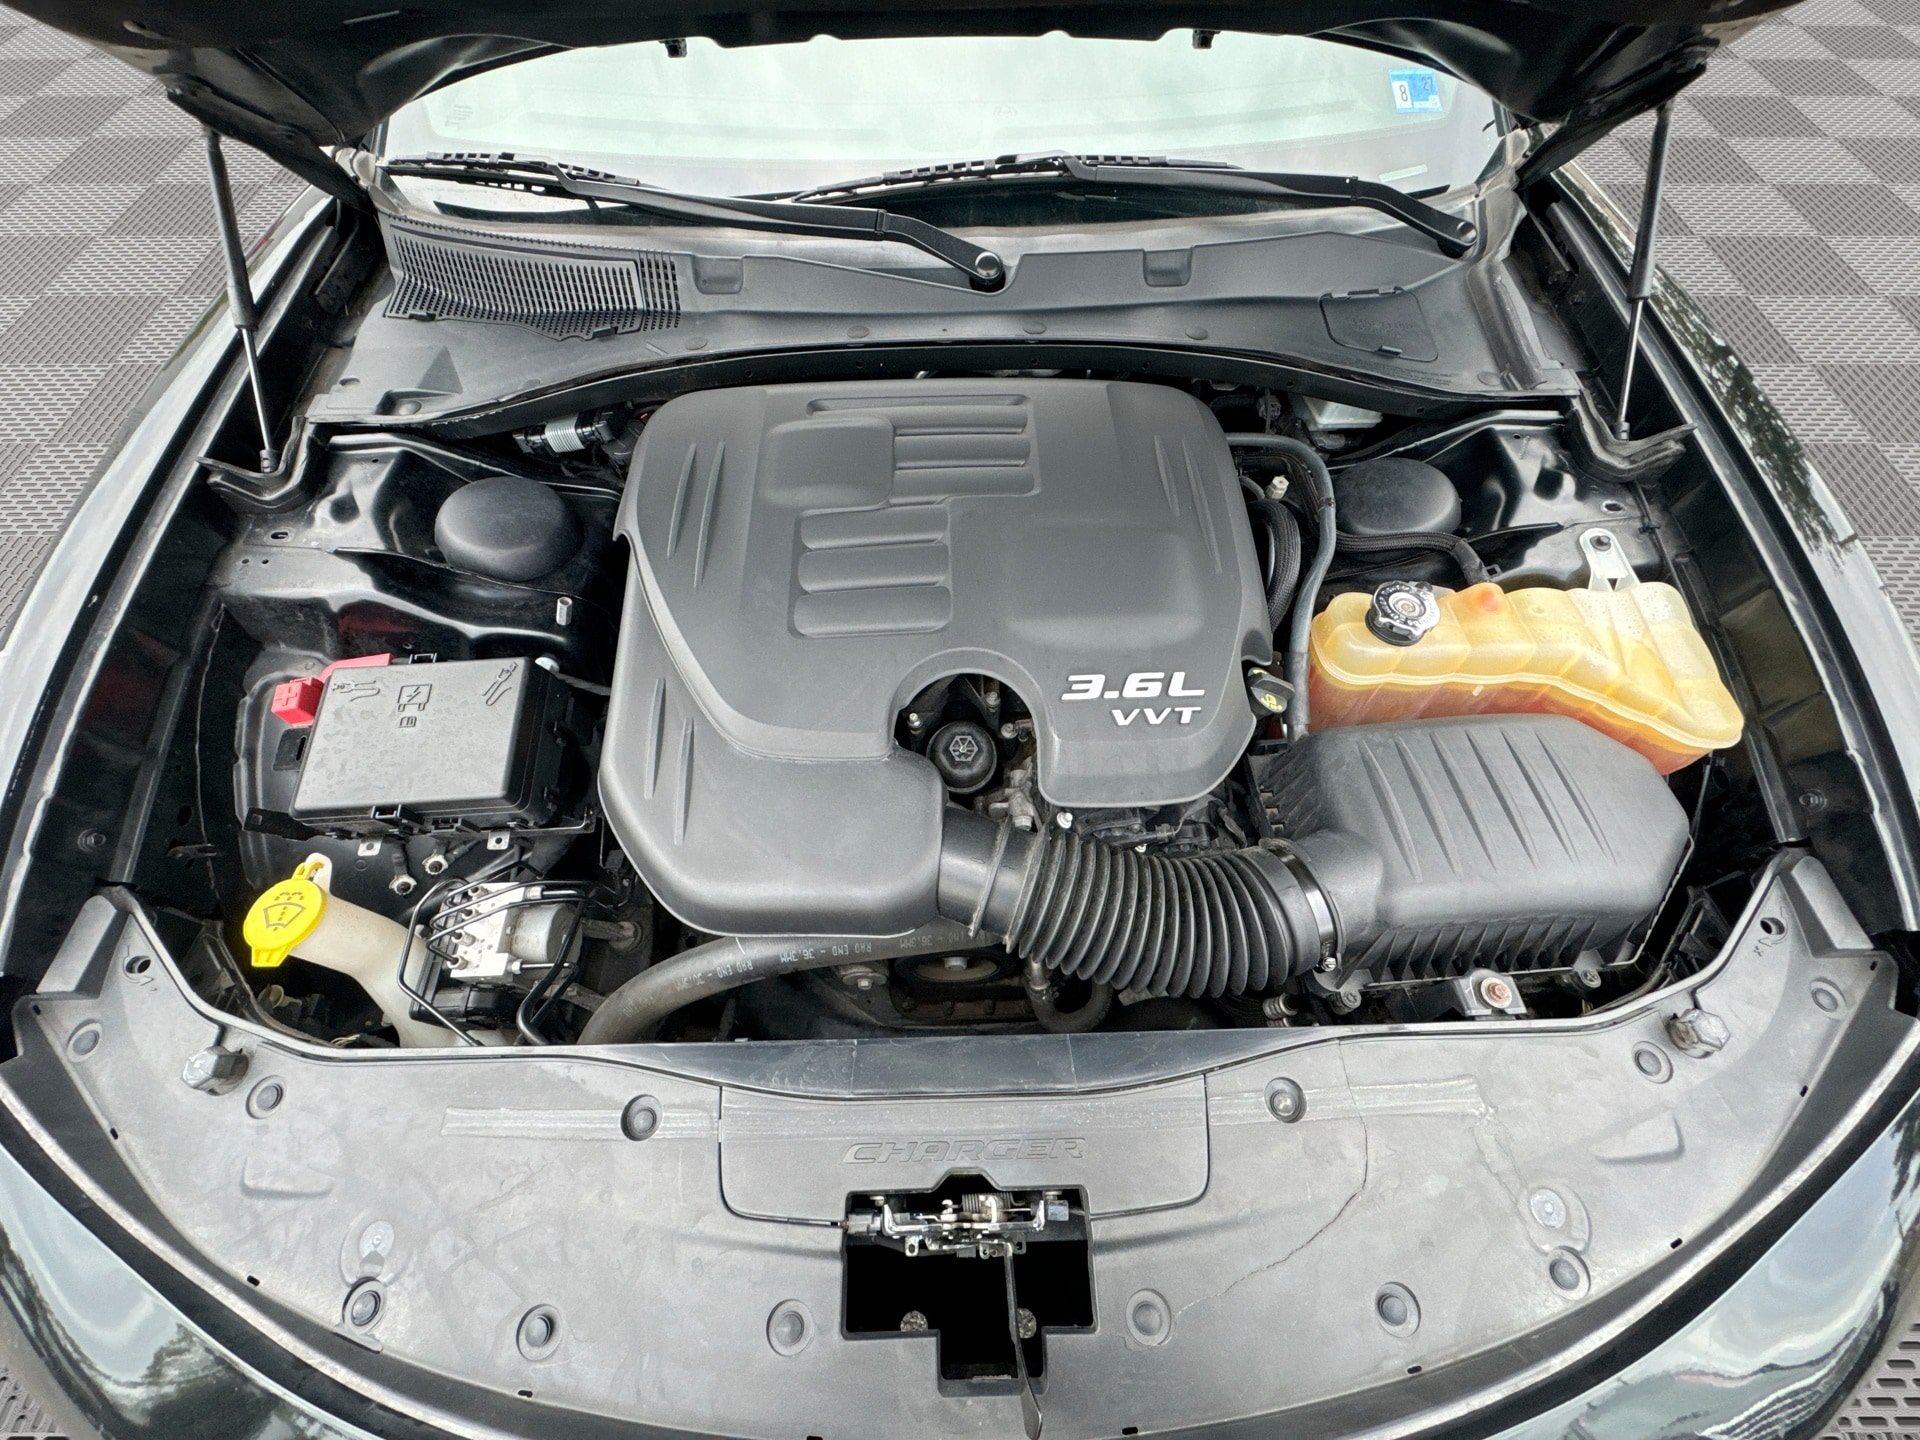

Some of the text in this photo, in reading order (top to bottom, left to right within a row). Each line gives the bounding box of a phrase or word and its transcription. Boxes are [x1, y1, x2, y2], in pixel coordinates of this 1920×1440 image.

[1399, 84, 1408, 102] 8
[1061, 671, 1205, 701] 3.6L
[1111, 706, 1202, 726] VVT
[854, 942, 872, 954] RAD
[843, 1137, 1086, 1164] CHARGER
